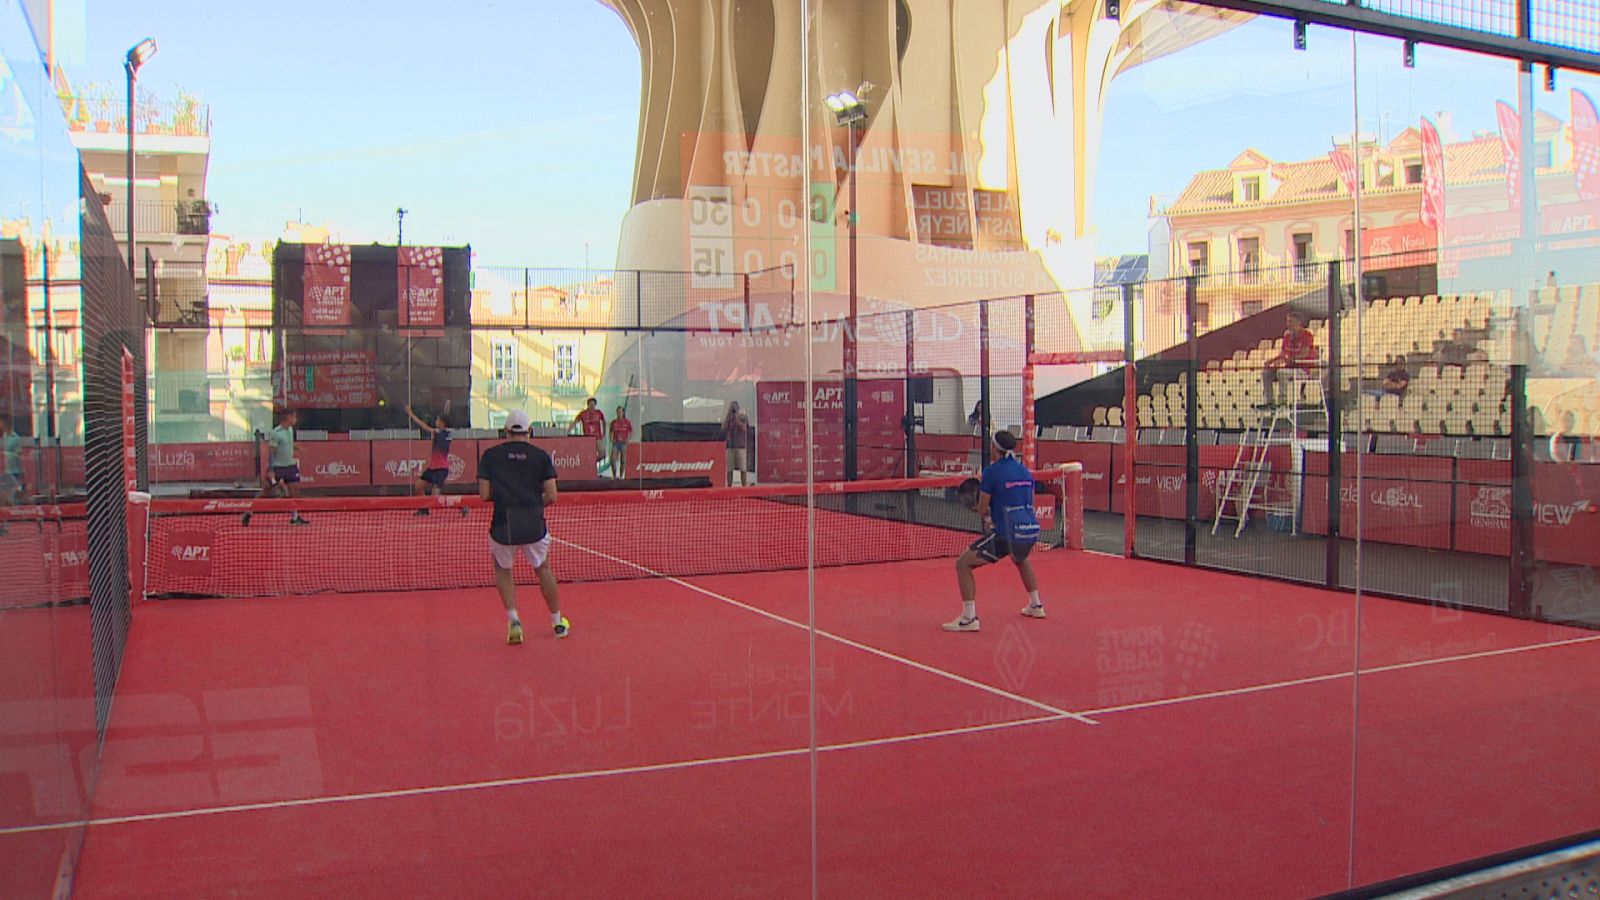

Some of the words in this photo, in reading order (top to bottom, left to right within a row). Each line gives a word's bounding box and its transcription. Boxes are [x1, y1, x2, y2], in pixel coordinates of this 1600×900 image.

[815, 387, 843, 400] APT
[158, 448, 195, 466] Luzía
[397, 459, 426, 471] APT
[182, 545, 211, 557] APT
